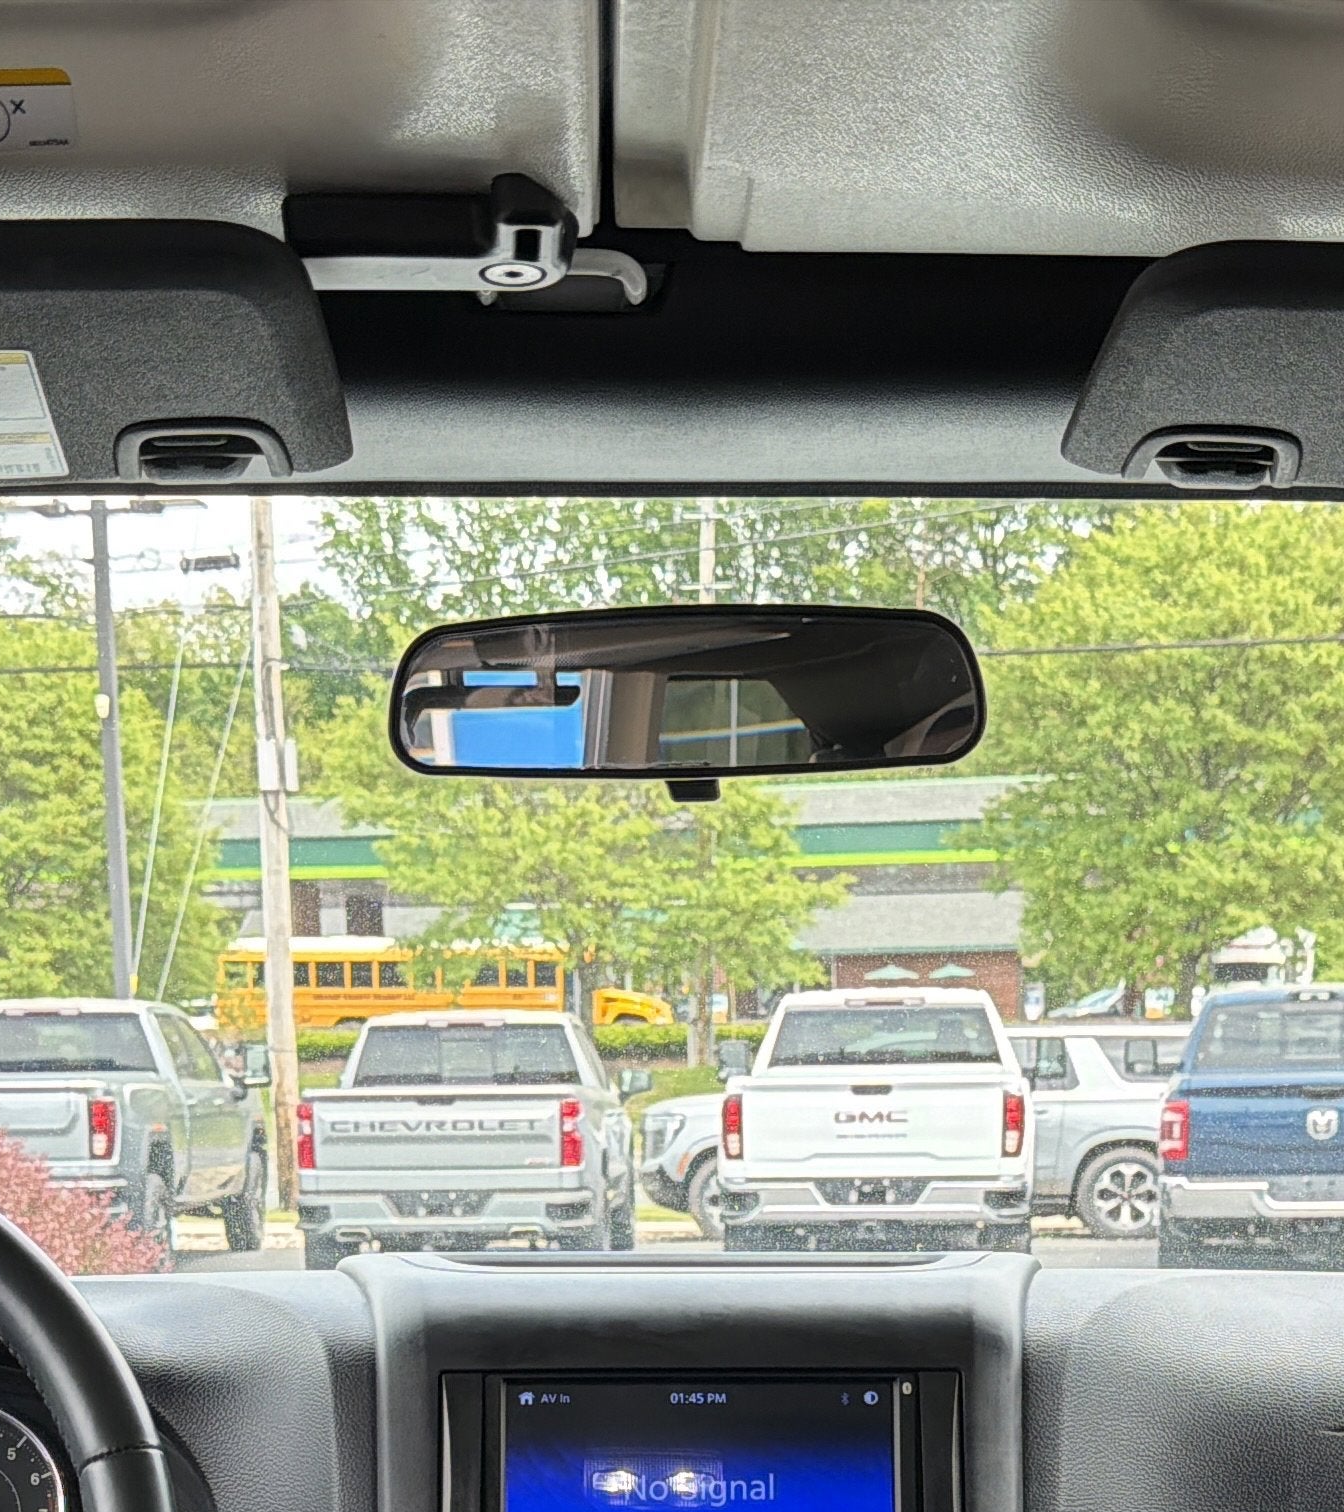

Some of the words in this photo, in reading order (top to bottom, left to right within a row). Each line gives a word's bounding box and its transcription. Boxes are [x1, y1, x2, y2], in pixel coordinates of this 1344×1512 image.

[834, 1110, 909, 1124] GMC
[330, 1118, 542, 1133] CHEVROLET
[540, 1393, 556, 1404] AV
[669, 1392, 704, 1404] 01:45
[706, 1393, 727, 1404] PM
[7, 1448, 17, 1460] 5
[30, 1473, 40, 1486] 6
[624, 1474, 669, 1501] No
[681, 1473, 775, 1505] Signal
